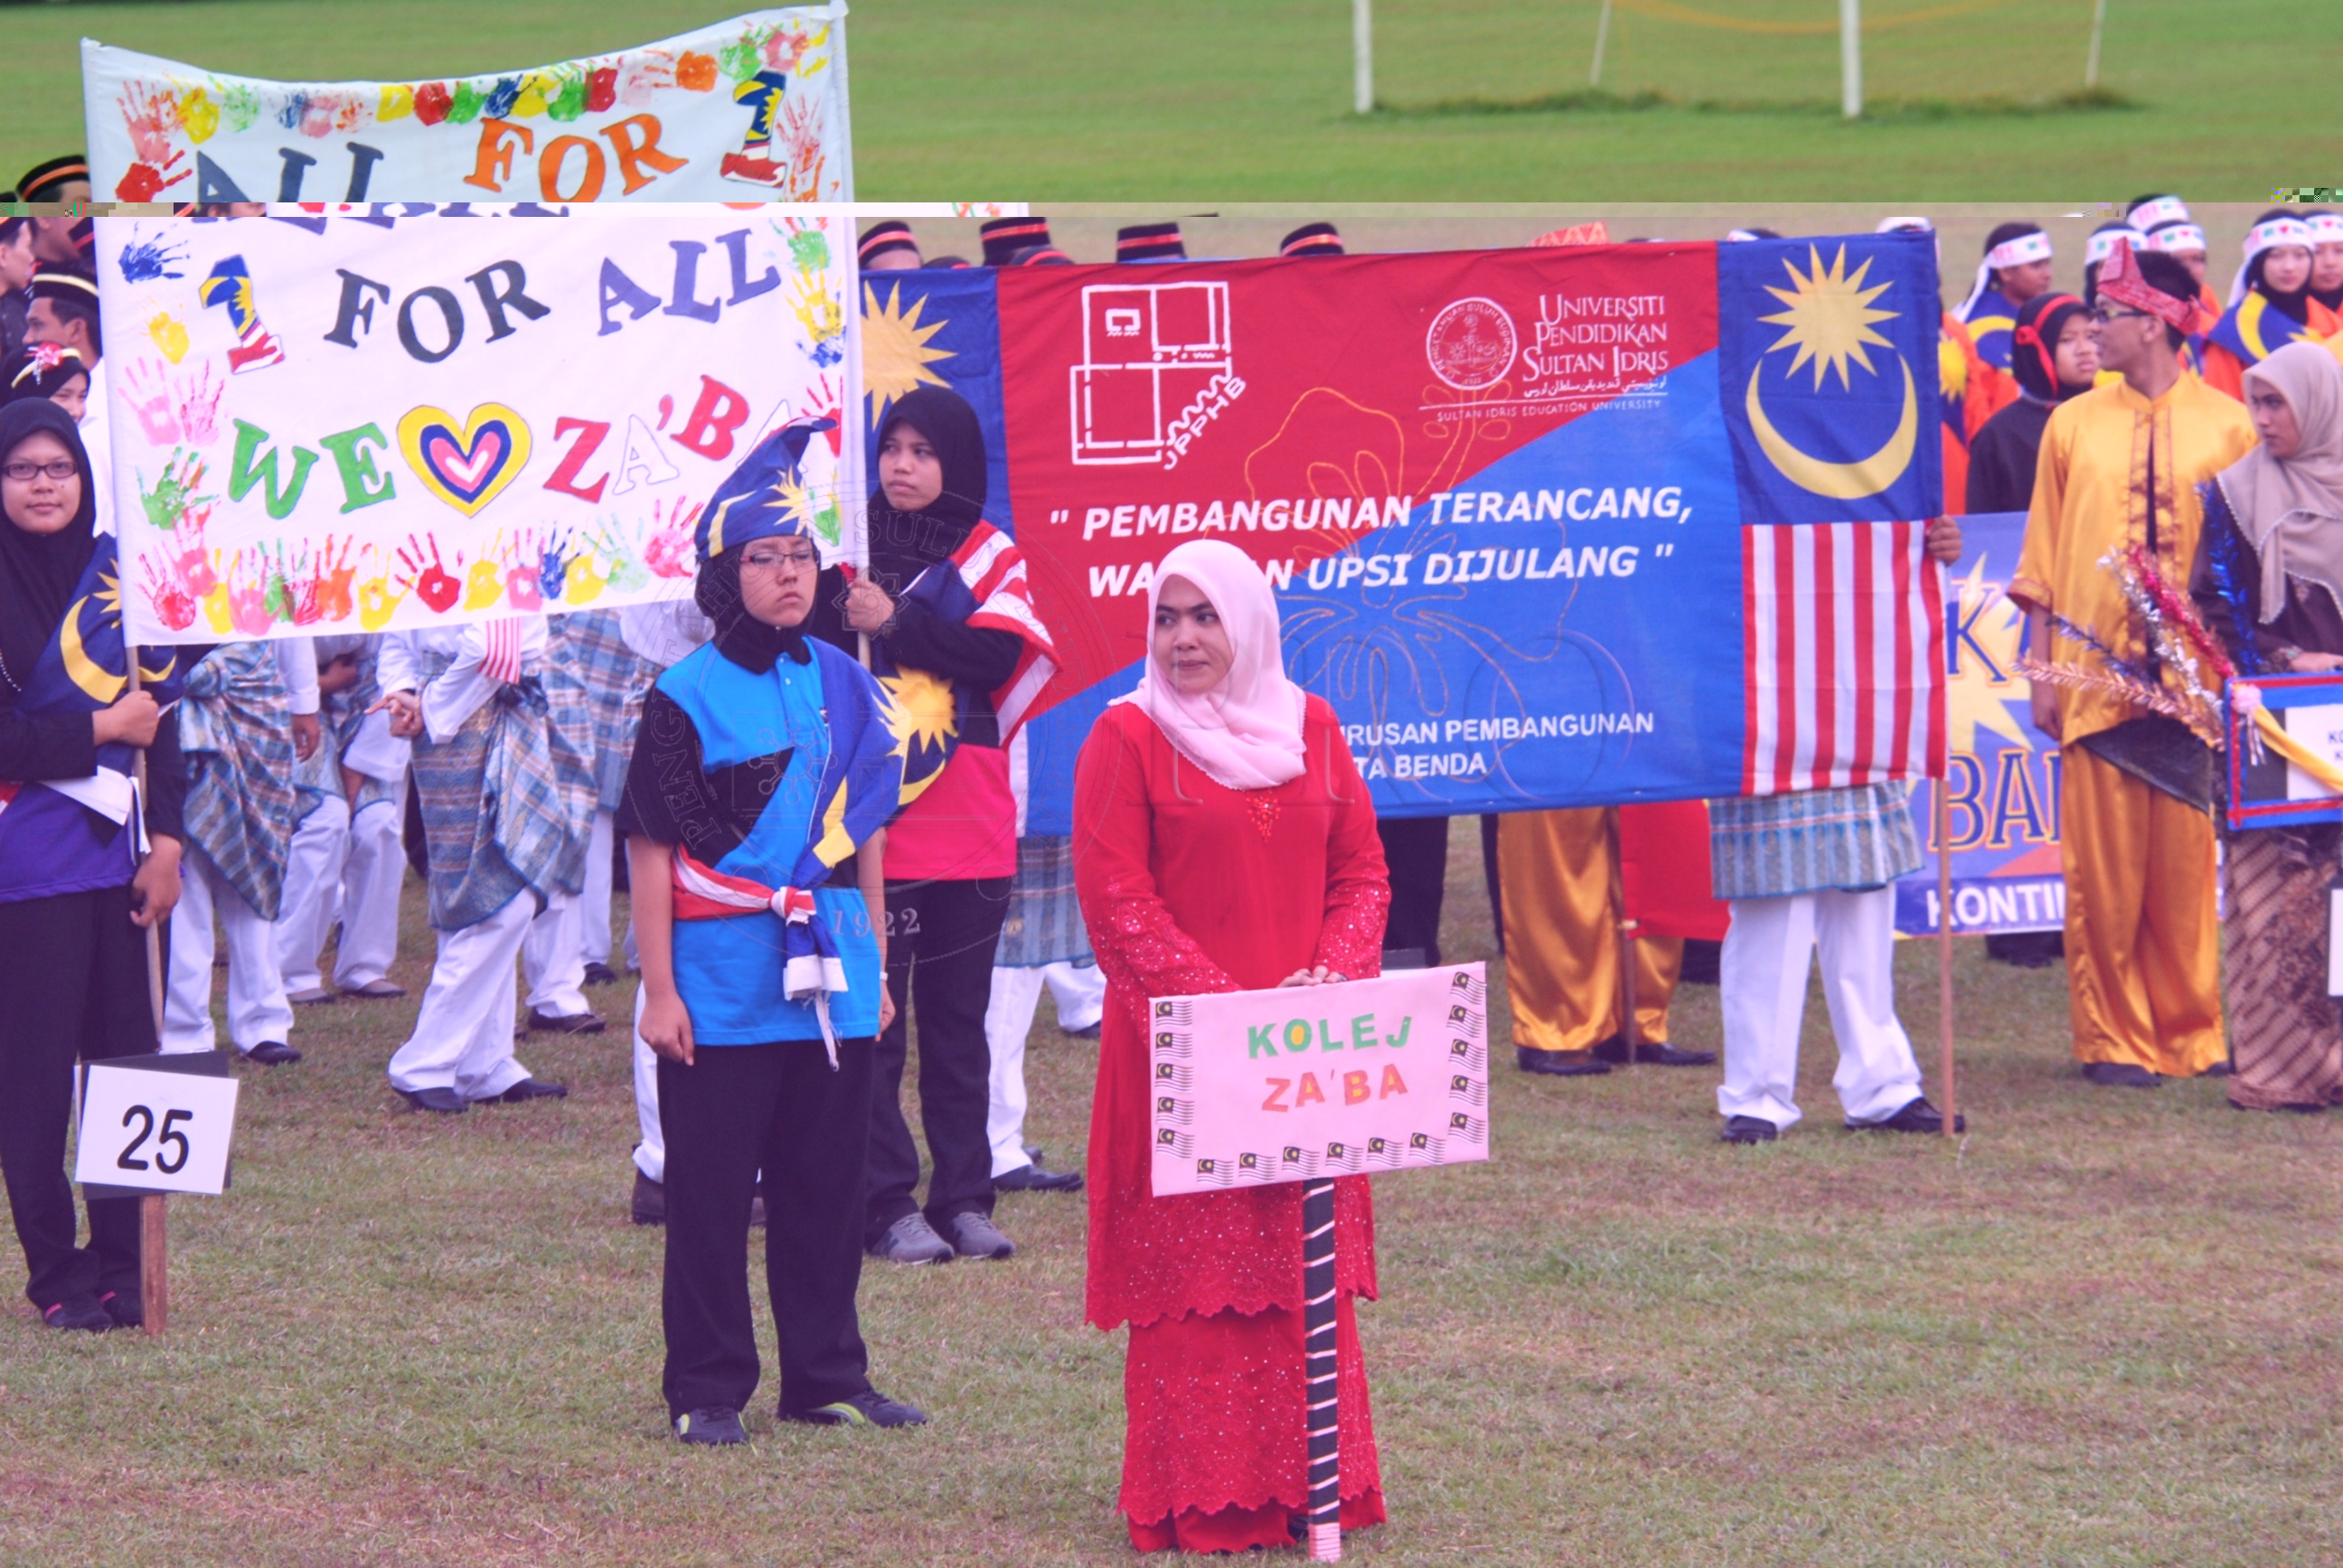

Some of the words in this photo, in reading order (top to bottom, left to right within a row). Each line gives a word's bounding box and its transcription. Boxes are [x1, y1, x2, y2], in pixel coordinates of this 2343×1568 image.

[192, 142, 395, 235] ALL
[462, 112, 690, 204] FOR
[324, 258, 551, 363] FOR
[597, 228, 782, 337] ALL
[1539, 294, 1665, 326] UNIVERSITI
[1534, 322, 1668, 354] PENDIDIKAN
[1522, 346, 1604, 382] SULTAN
[1613, 345, 1670, 377] IDRIS
[1163, 377, 1247, 470] JPPHB
[1437, 408, 1482, 422] SULTAN
[1485, 406, 1517, 418] IDRIS
[1522, 401, 1587, 417] EDUCATION
[1592, 399, 1661, 411] UNIVERSITY
[228, 418, 397, 520] WE
[1082, 494, 1412, 541] PEMBANGUNAN
[1430, 486, 1692, 525] TERANCANG,
[1307, 554, 1412, 590] UPSI
[1423, 546, 1639, 585] DIJULANG
[1446, 712, 1654, 743] PEMBANGUNAN
[1395, 752, 1488, 778] BENDA
[1247, 1013, 1412, 1059] KOLEJ
[1262, 1063, 1408, 1113] ZA'BA
[117, 1104, 193, 1175] 25
